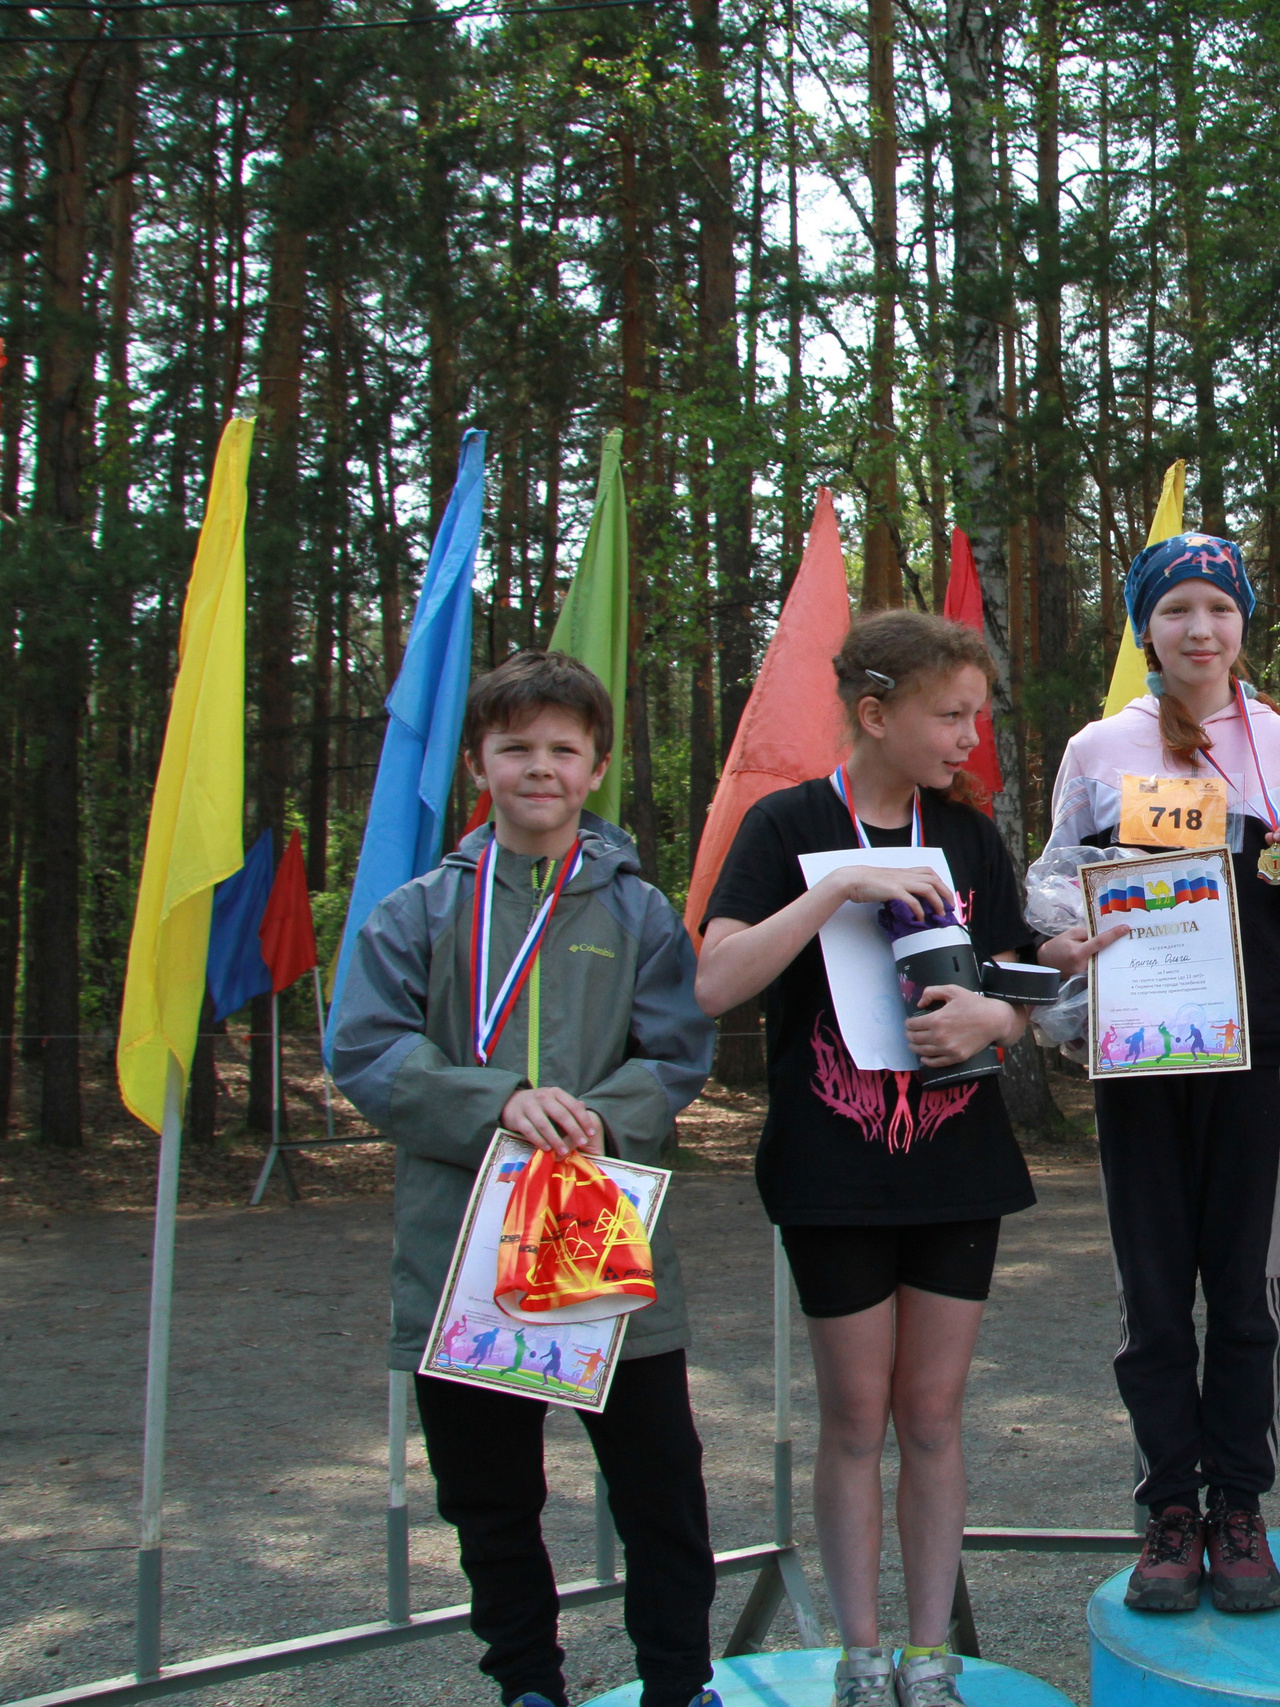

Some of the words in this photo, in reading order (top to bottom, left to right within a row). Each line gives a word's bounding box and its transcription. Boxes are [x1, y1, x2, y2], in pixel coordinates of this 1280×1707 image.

[1149, 806, 1202, 830] 718
[1272, 859, 1279, 870] 1
[1128, 920, 1199, 940] ГРАМОТА
